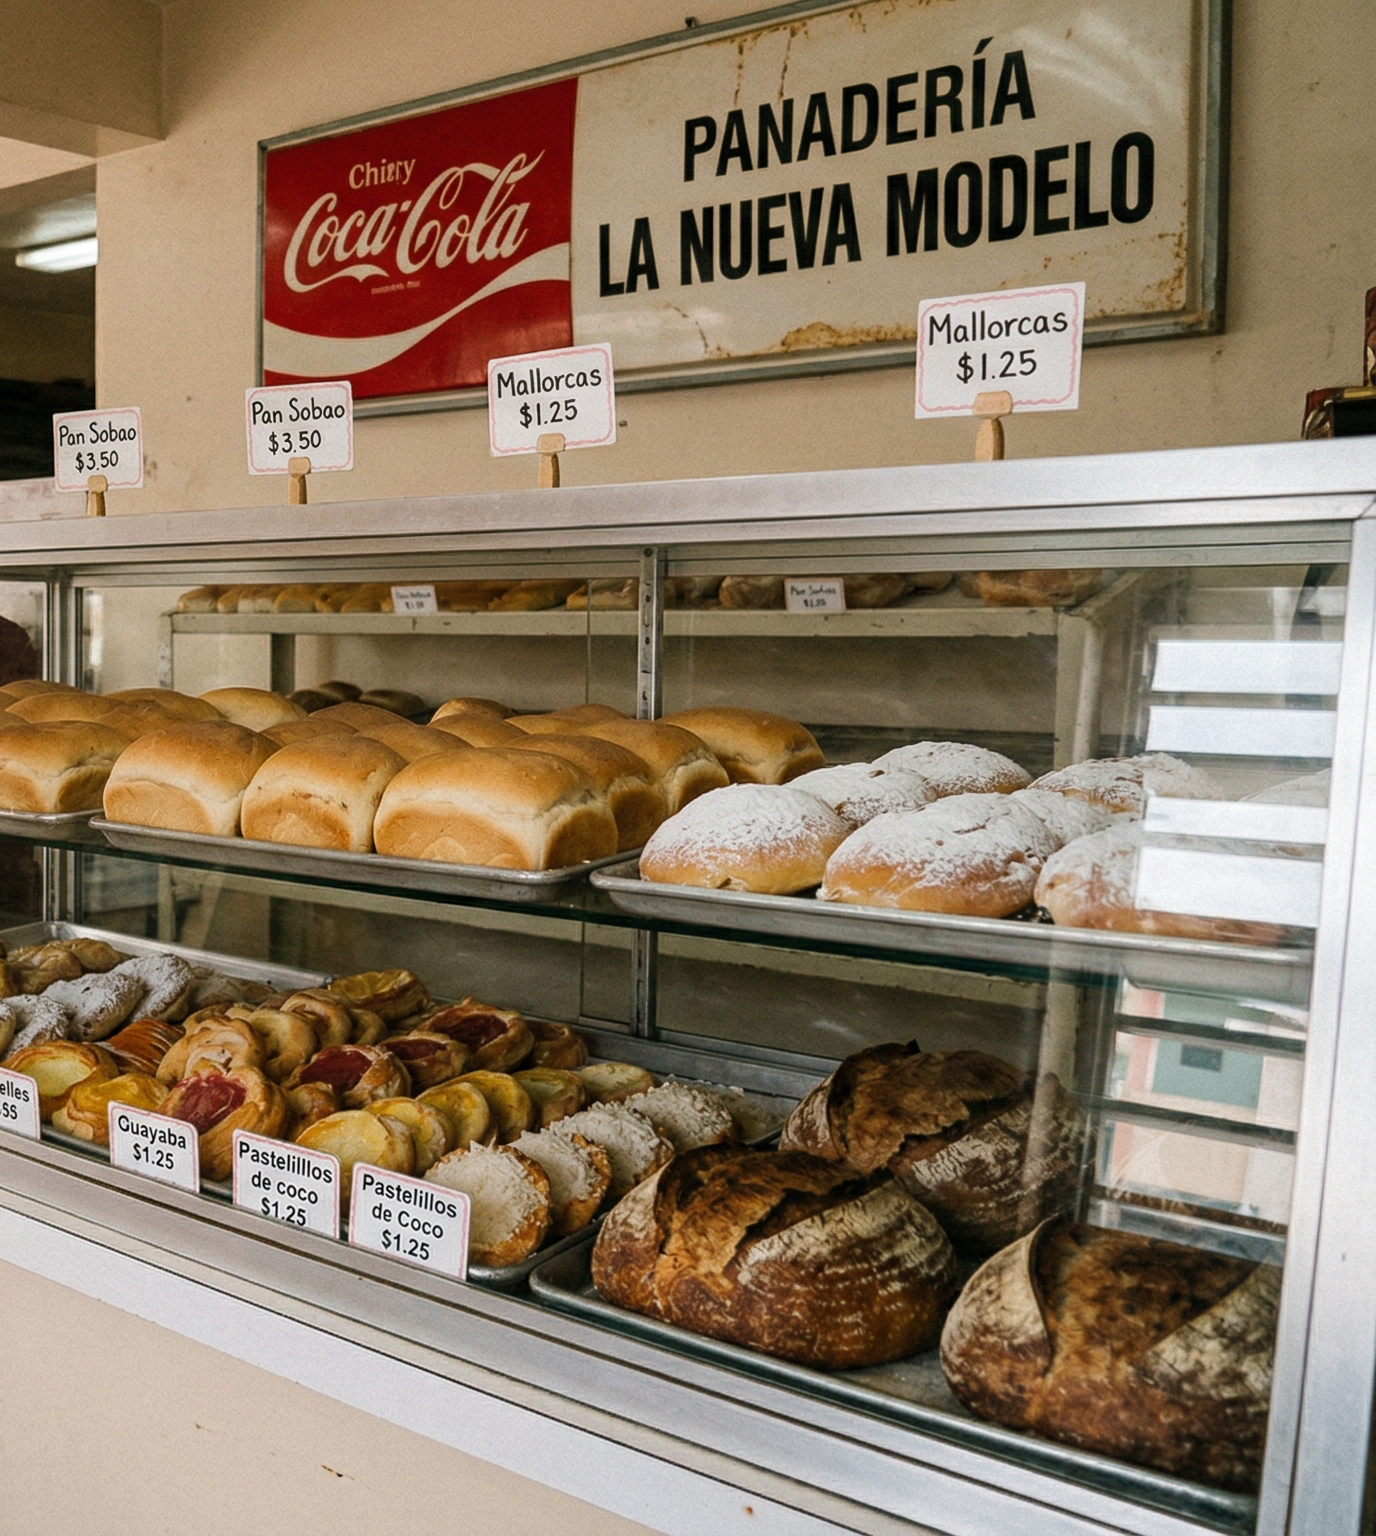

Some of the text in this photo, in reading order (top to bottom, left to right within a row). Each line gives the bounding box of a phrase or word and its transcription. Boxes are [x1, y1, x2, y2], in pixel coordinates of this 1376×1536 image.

[683, 36, 1036, 183] PANADERÍA
[283, 149, 546, 293] Coca-Cola
[598, 131, 1155, 298] LA NUEVA MODELO
[929, 310, 1069, 346] Mallorcas
[497, 367, 602, 399] Mallorcas
[956, 349, 1037, 384] $1.25
[251, 396, 346, 426] Pan Sobao
[519, 398, 578, 429] $1.25
[59, 421, 136, 447] Pan Sobao
[268, 429, 322, 456] $3.50
[75, 450, 119, 473] $3.50
[117, 1114, 187, 1150] Guayaba
[132, 1143, 175, 1171] $1.25
[251, 1170, 320, 1206] de coco
[362, 1173, 458, 1219] Pastelillos
[260, 1197, 307, 1227] $1.25
[371, 1202, 444, 1240] de Coco
[381, 1229, 430, 1261] $1.25
